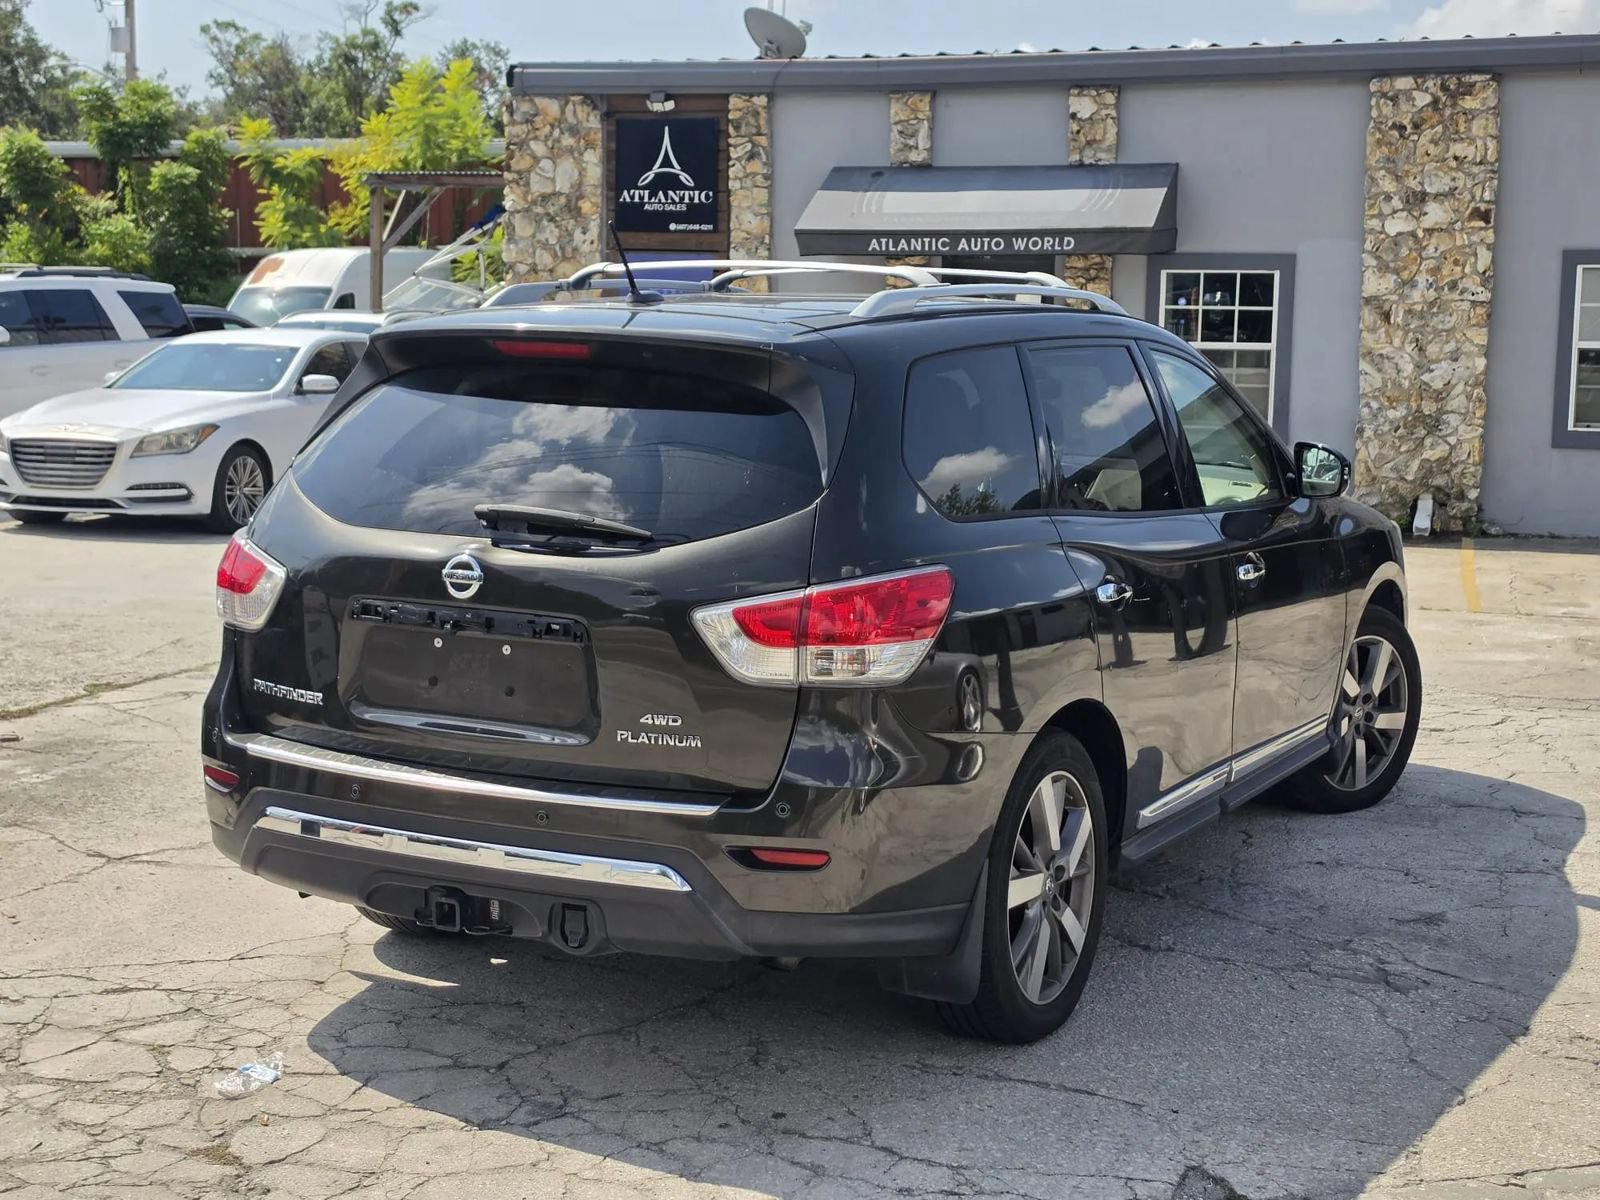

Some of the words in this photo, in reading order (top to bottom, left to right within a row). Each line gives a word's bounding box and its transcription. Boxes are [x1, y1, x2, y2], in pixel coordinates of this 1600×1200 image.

[619, 189, 713, 204] ATLANTIC
[643, 203, 663, 211] AUTO
[664, 203, 687, 211] SALES
[868, 238, 950, 251] ATLANTIC
[957, 237, 1005, 251] AUTO
[1012, 236, 1075, 250] WORLD
[444, 572, 480, 581] NISSAN
[253, 678, 324, 706] PATHFINDER
[639, 713, 682, 726] 4WD
[616, 730, 702, 748] PLATINUM
